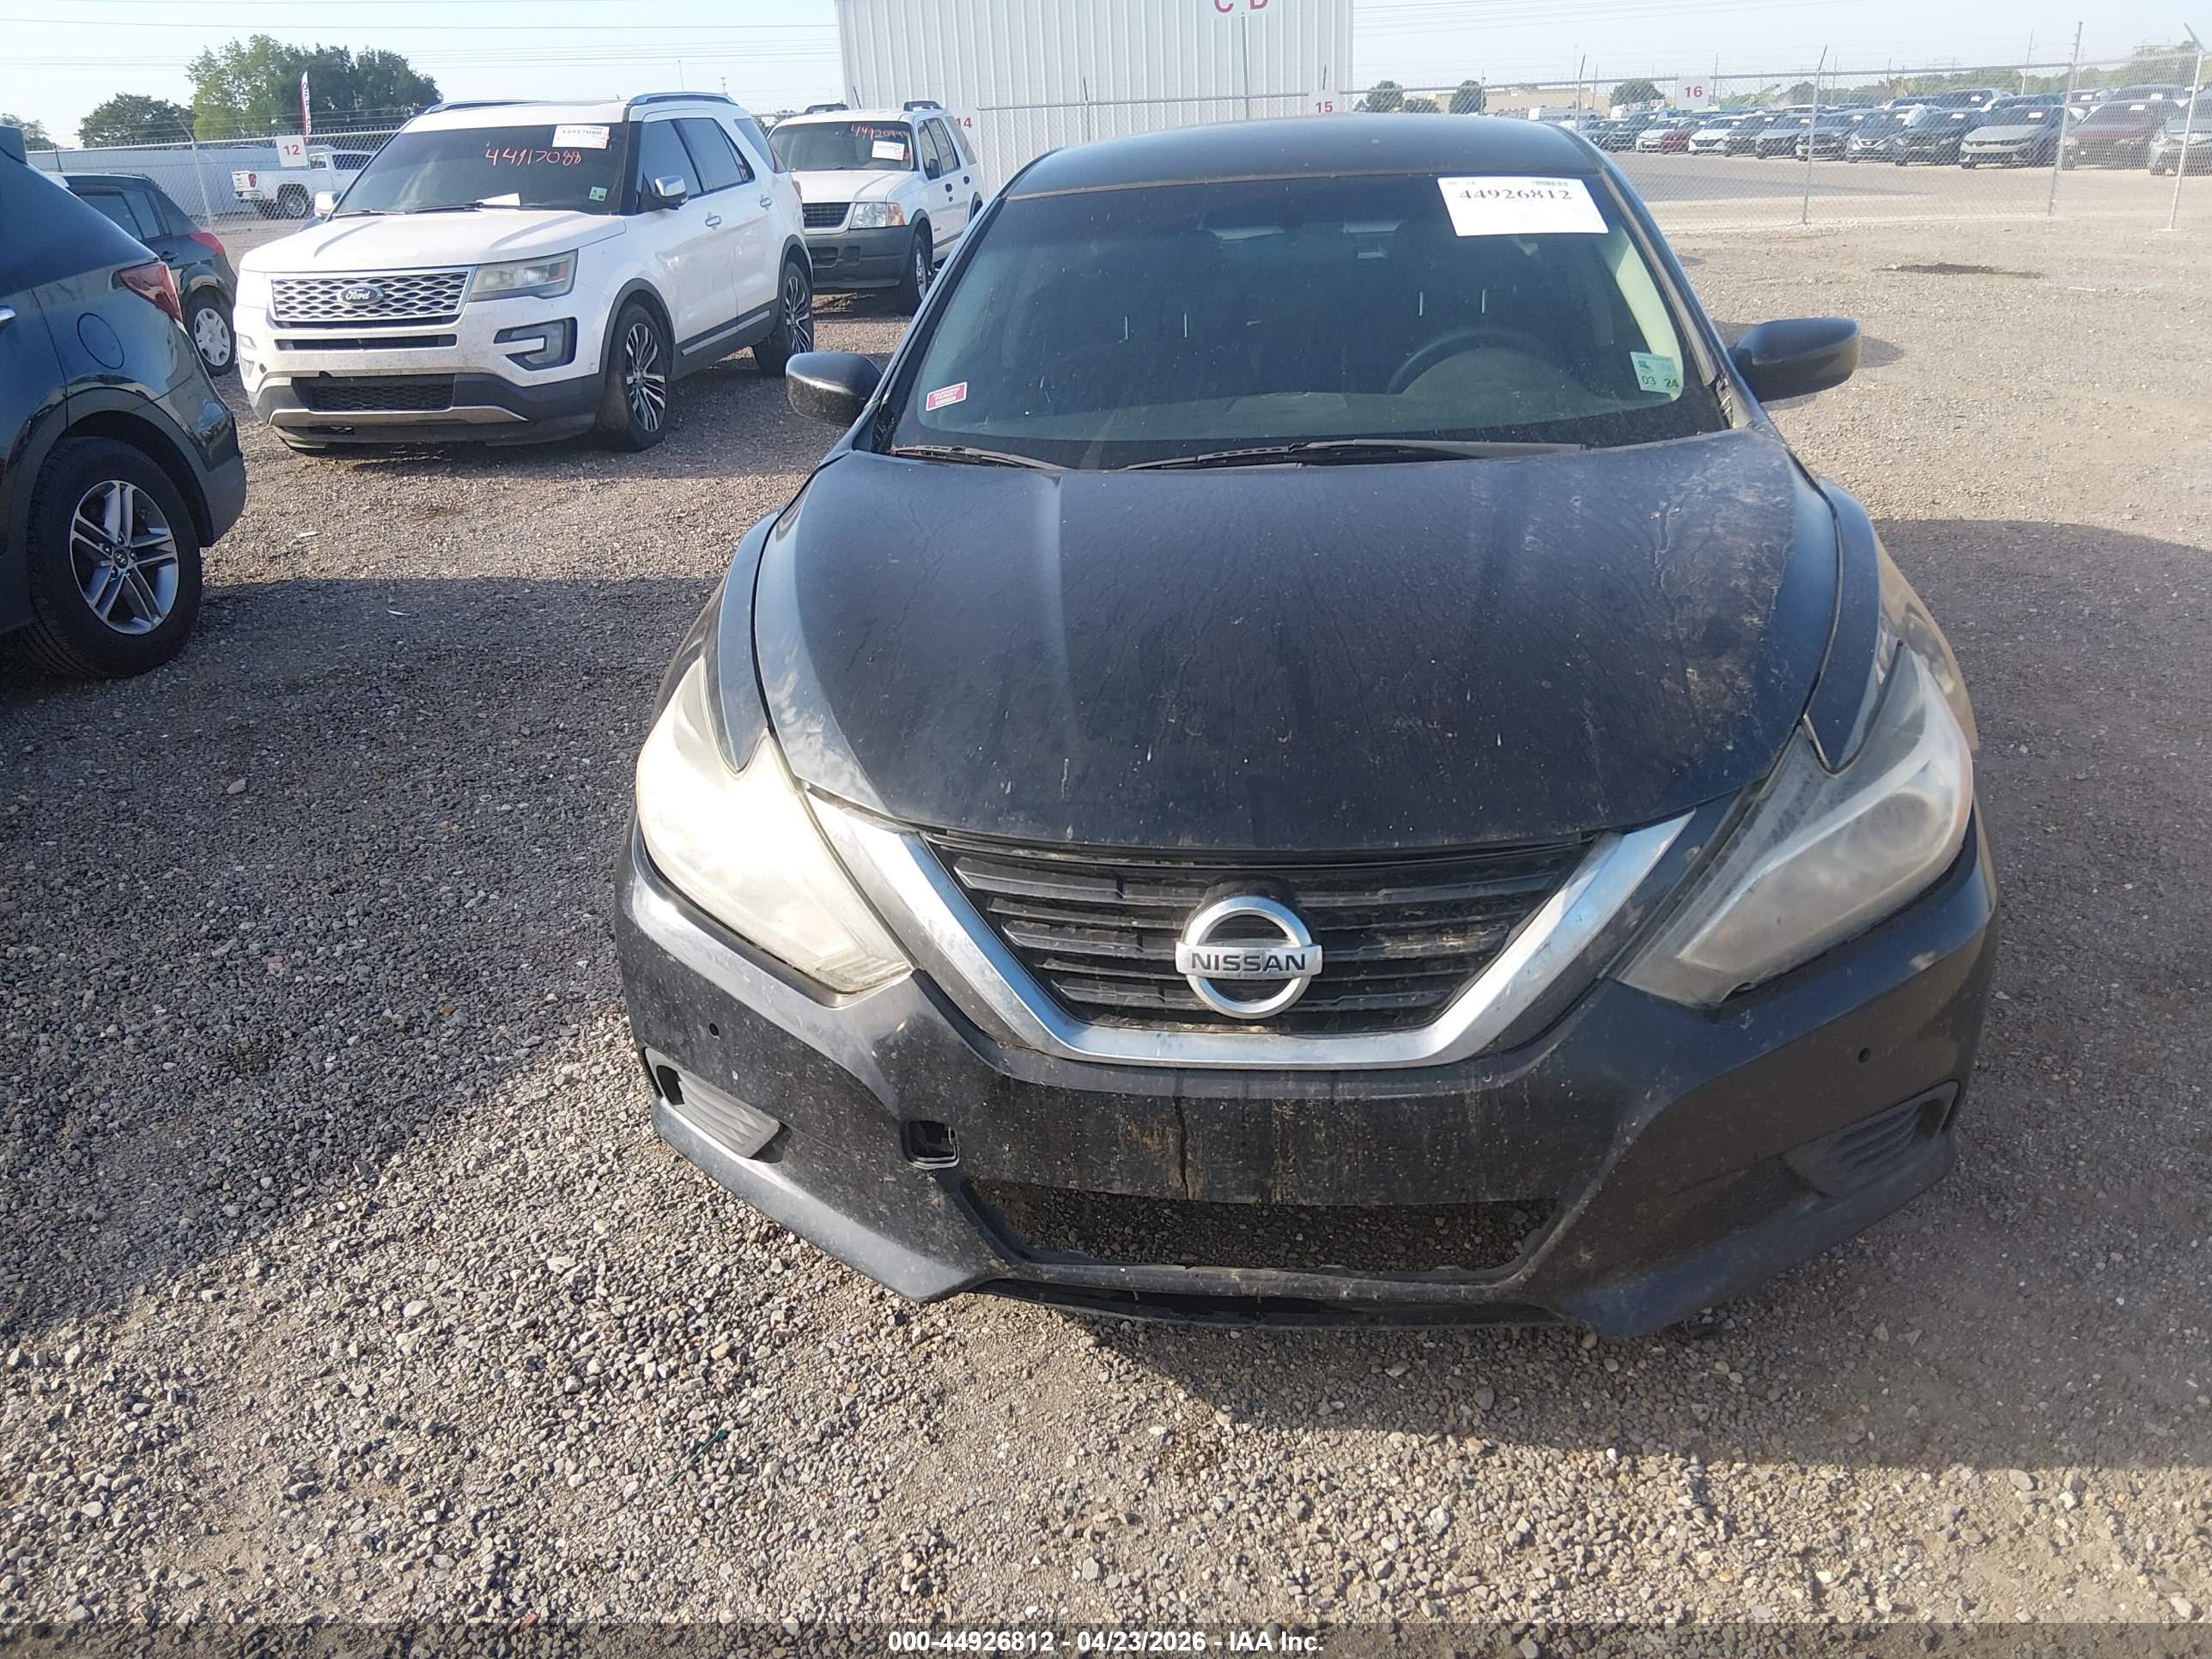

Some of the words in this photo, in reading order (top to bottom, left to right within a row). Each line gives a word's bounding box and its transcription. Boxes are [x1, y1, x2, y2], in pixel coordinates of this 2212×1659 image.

[1685, 86, 1703, 98] 16
[1316, 101, 1334, 113] 15
[955, 117, 973, 129] 14
[283, 144, 301, 156] 12
[485, 148, 582, 166] 44917088
[1460, 189, 1573, 199] 44926812
[345, 289, 371, 301] Ford
[1641, 375, 1656, 386] 03
[1663, 378, 1680, 388] 24
[1191, 952, 1306, 972] NISSAN
